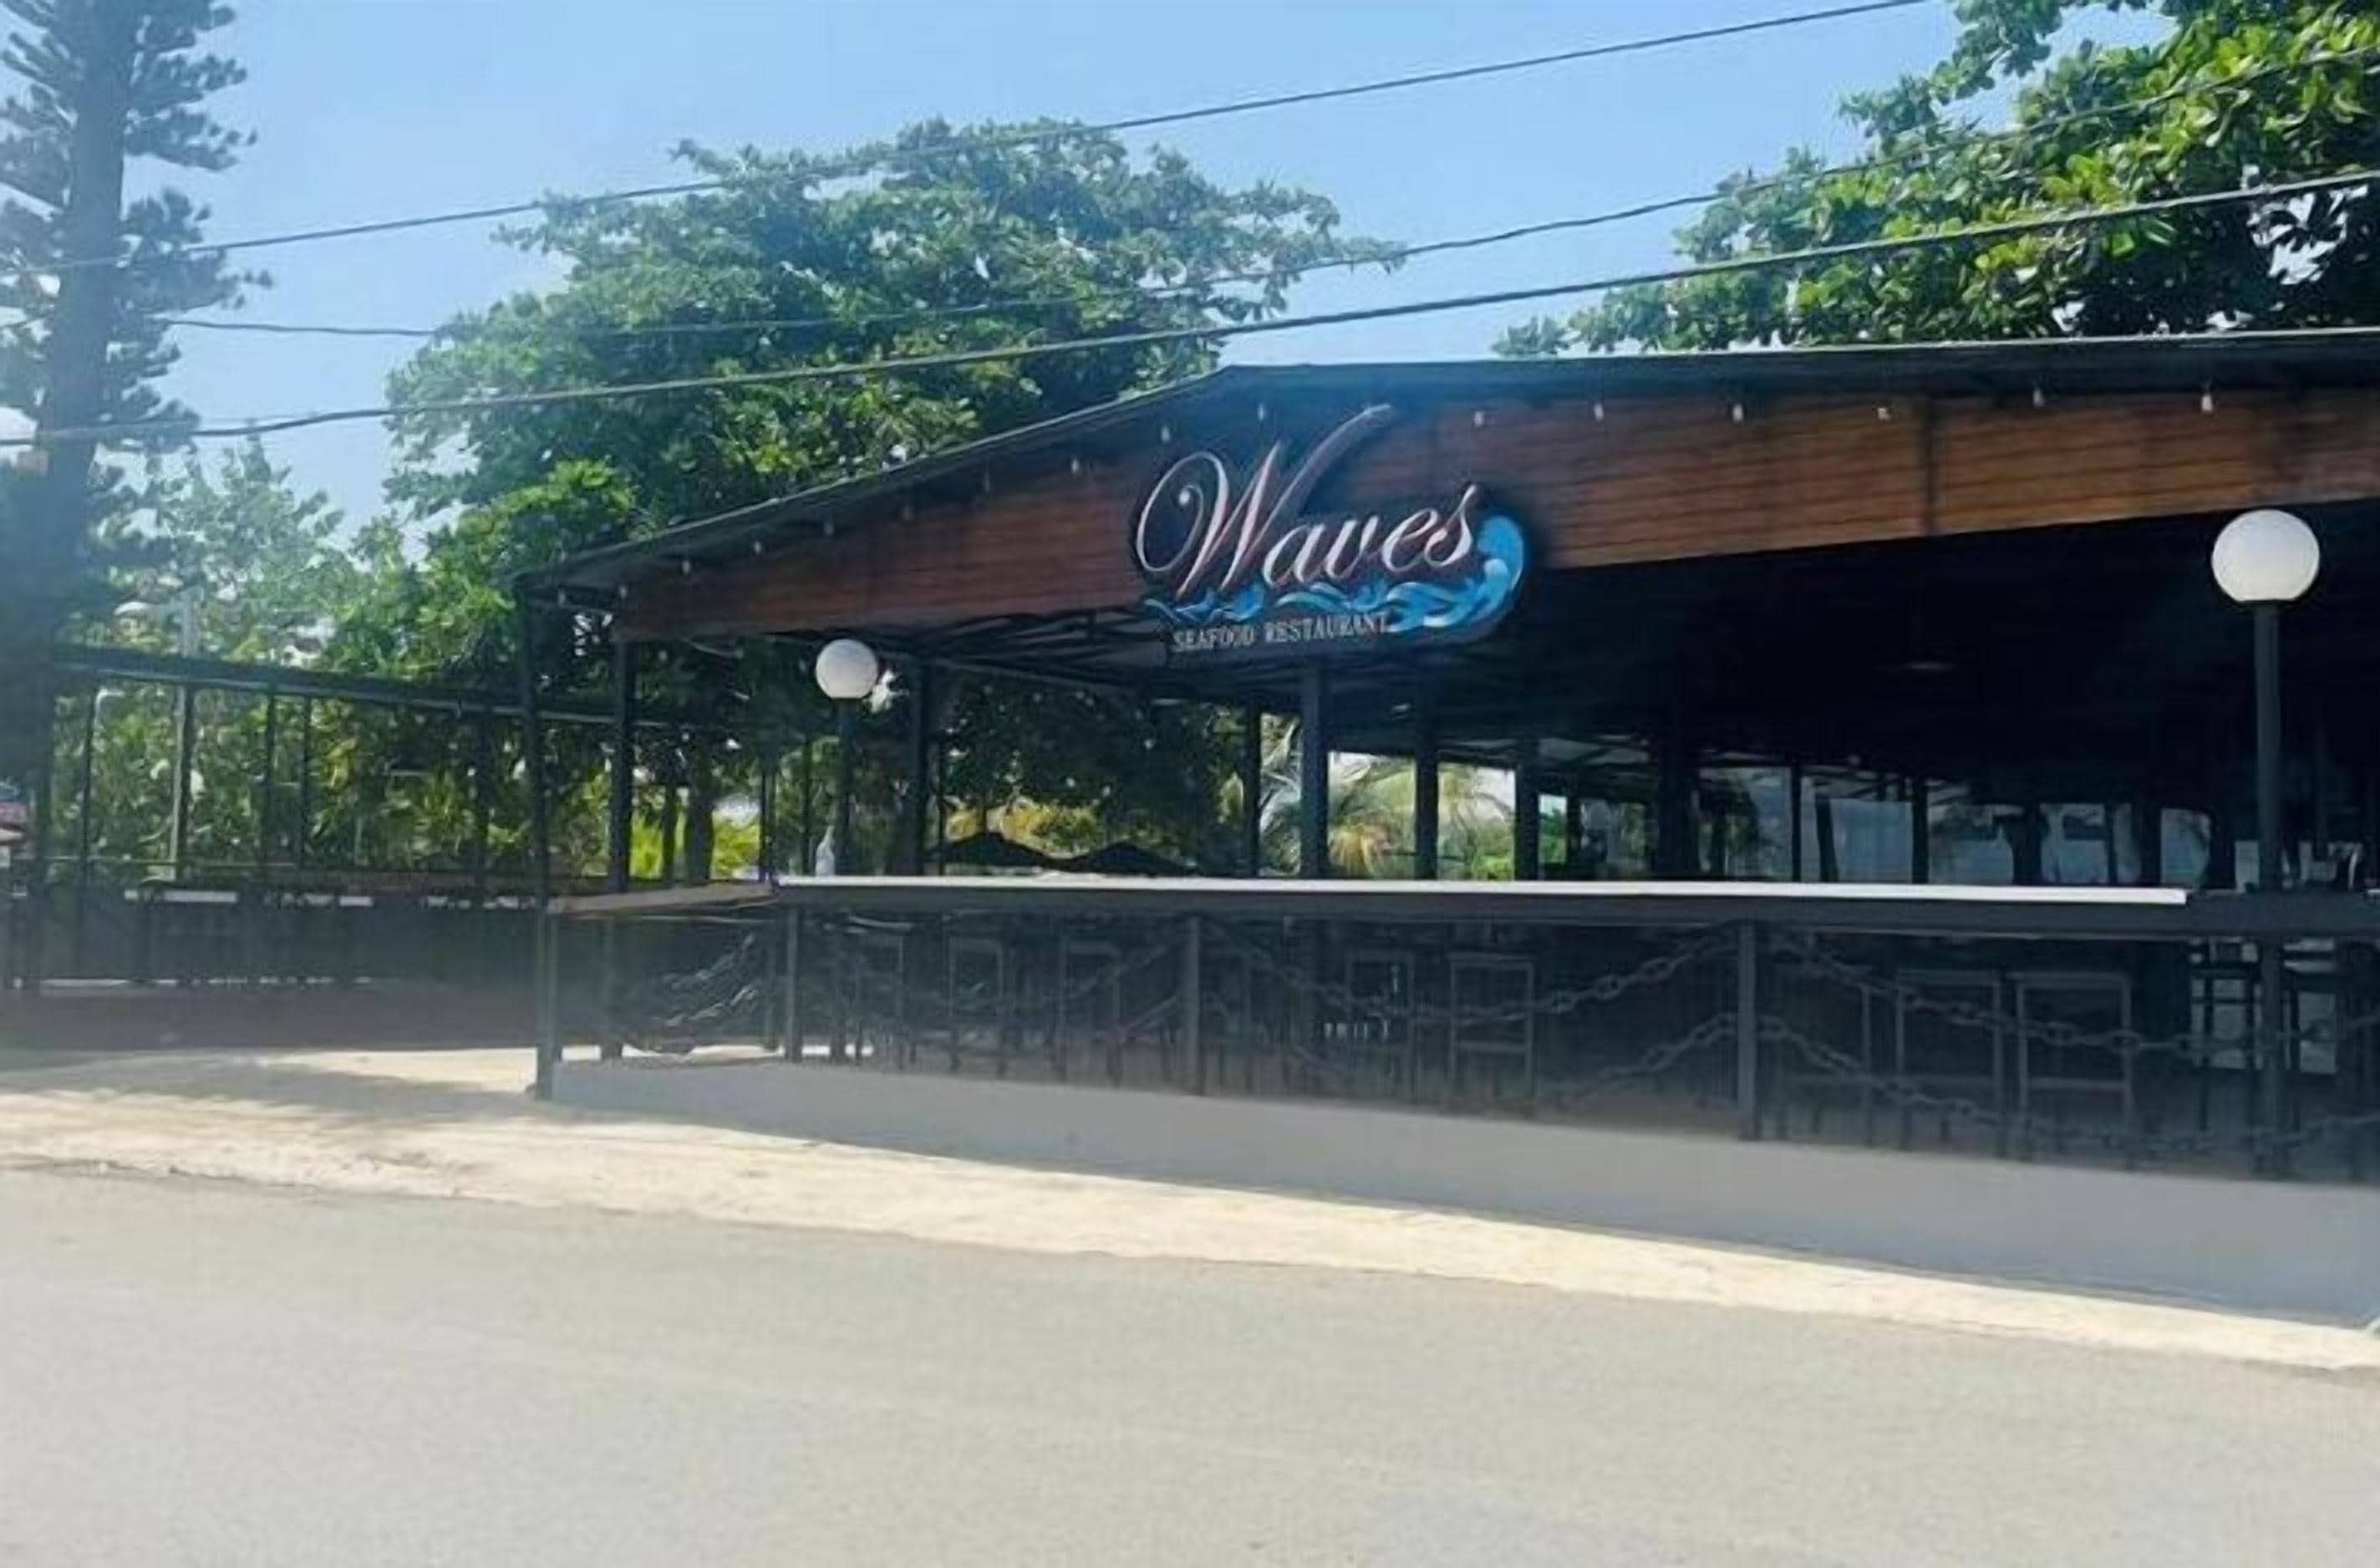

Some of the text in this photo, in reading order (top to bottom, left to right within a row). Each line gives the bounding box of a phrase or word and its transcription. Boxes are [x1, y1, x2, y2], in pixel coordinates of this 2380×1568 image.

[1136, 404, 1478, 598] Waves
[1172, 611, 1391, 652] SEAFOOD RESTAURANT
